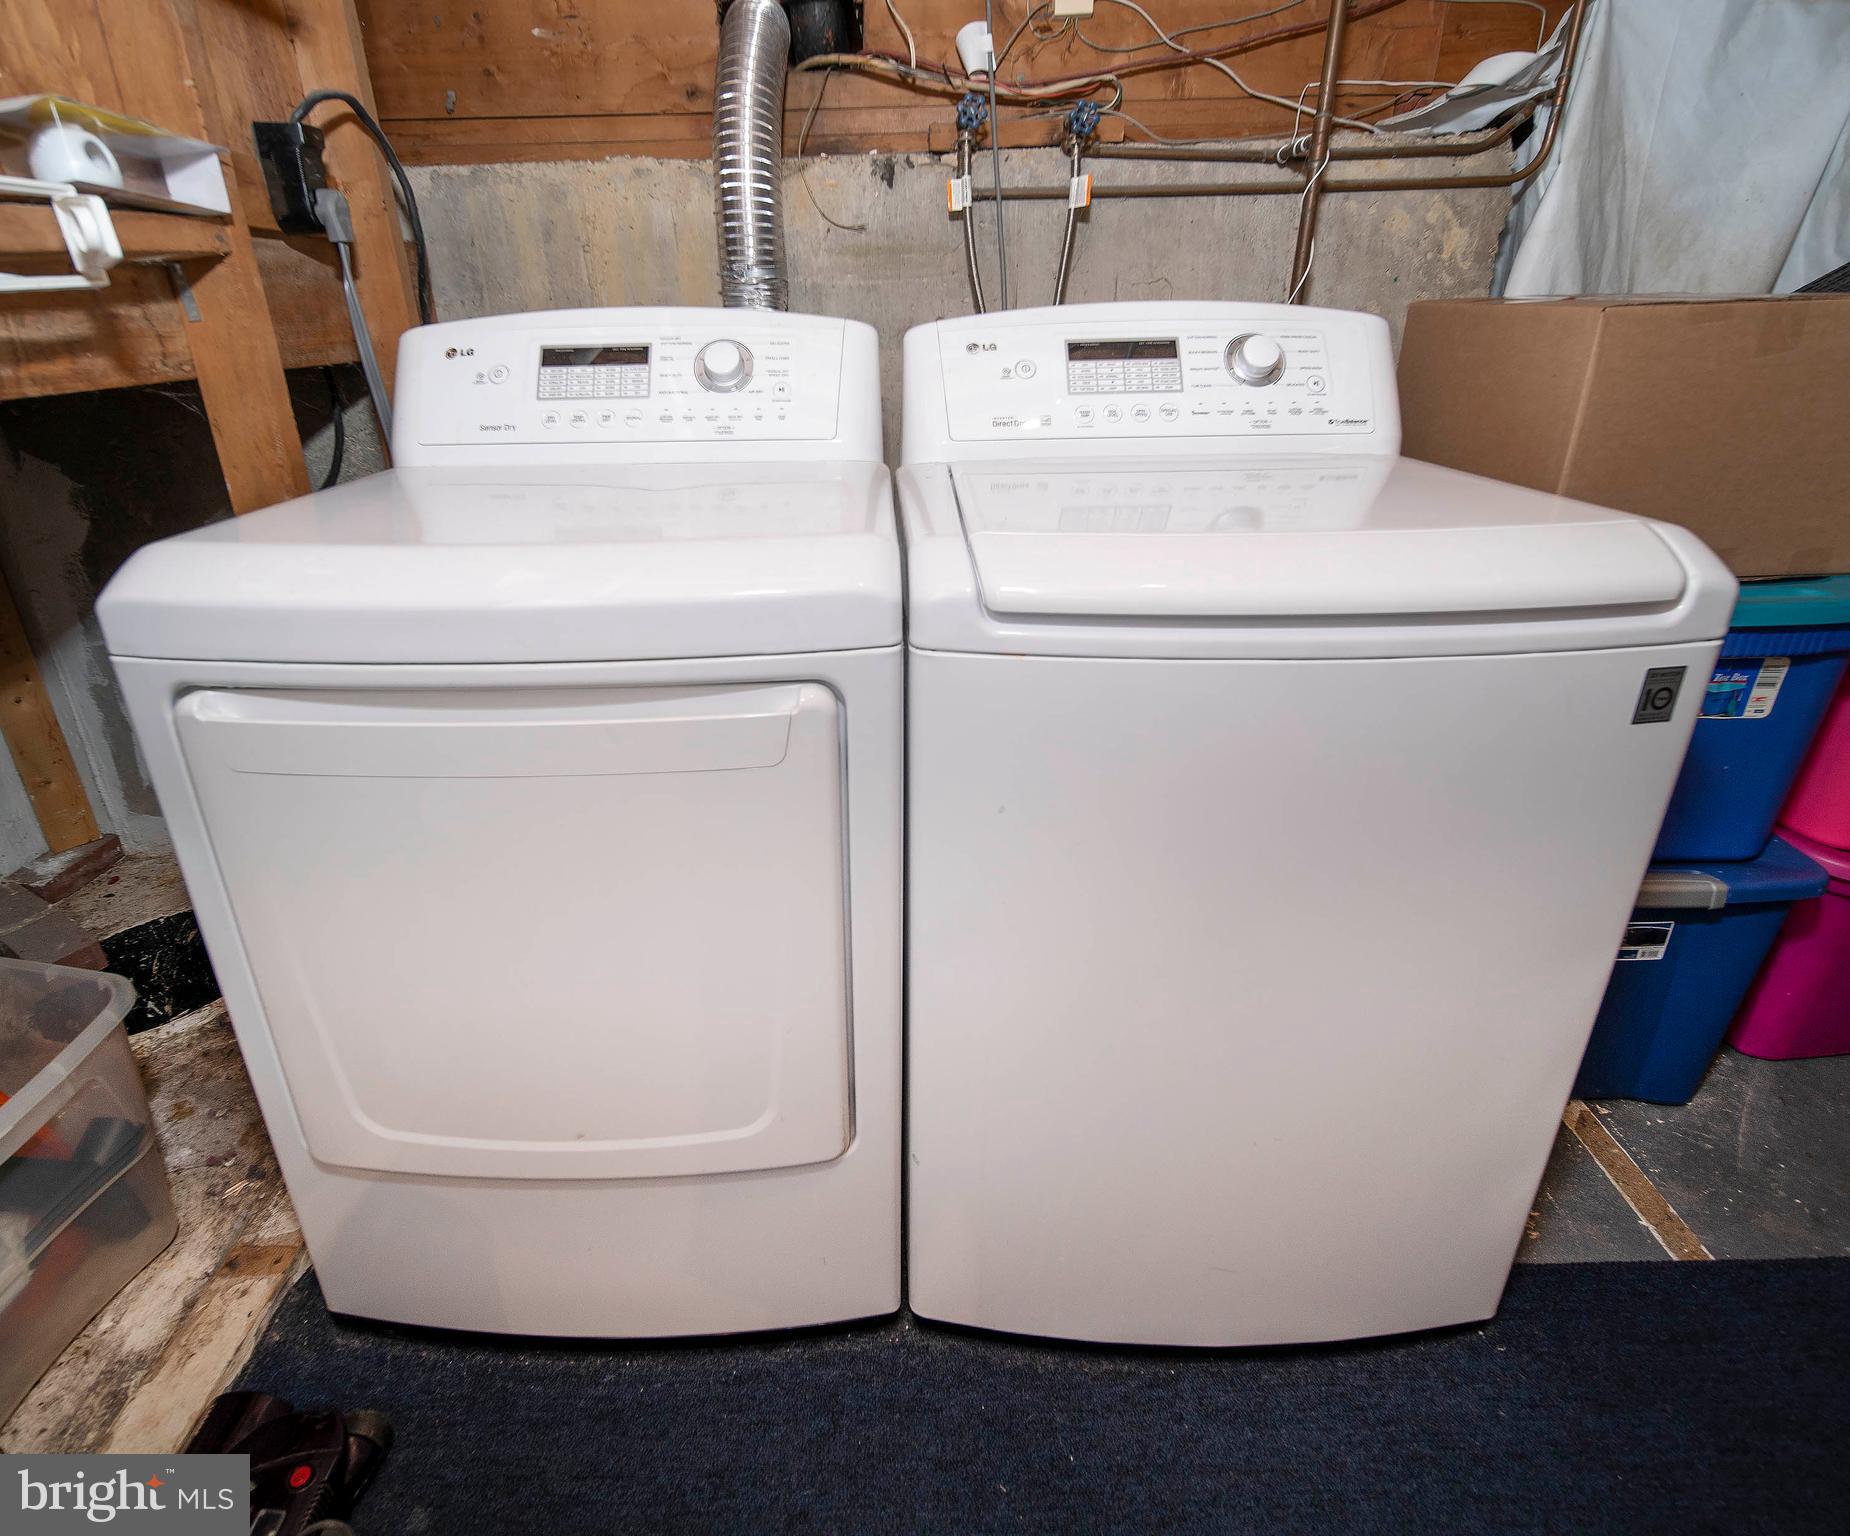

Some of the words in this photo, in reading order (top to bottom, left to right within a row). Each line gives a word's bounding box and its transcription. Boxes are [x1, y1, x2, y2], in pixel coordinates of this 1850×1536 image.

[982, 343, 997, 351] LG
[460, 348, 474, 356] LG
[503, 424, 516, 432] Dry
[992, 420, 1013, 428] Direct
